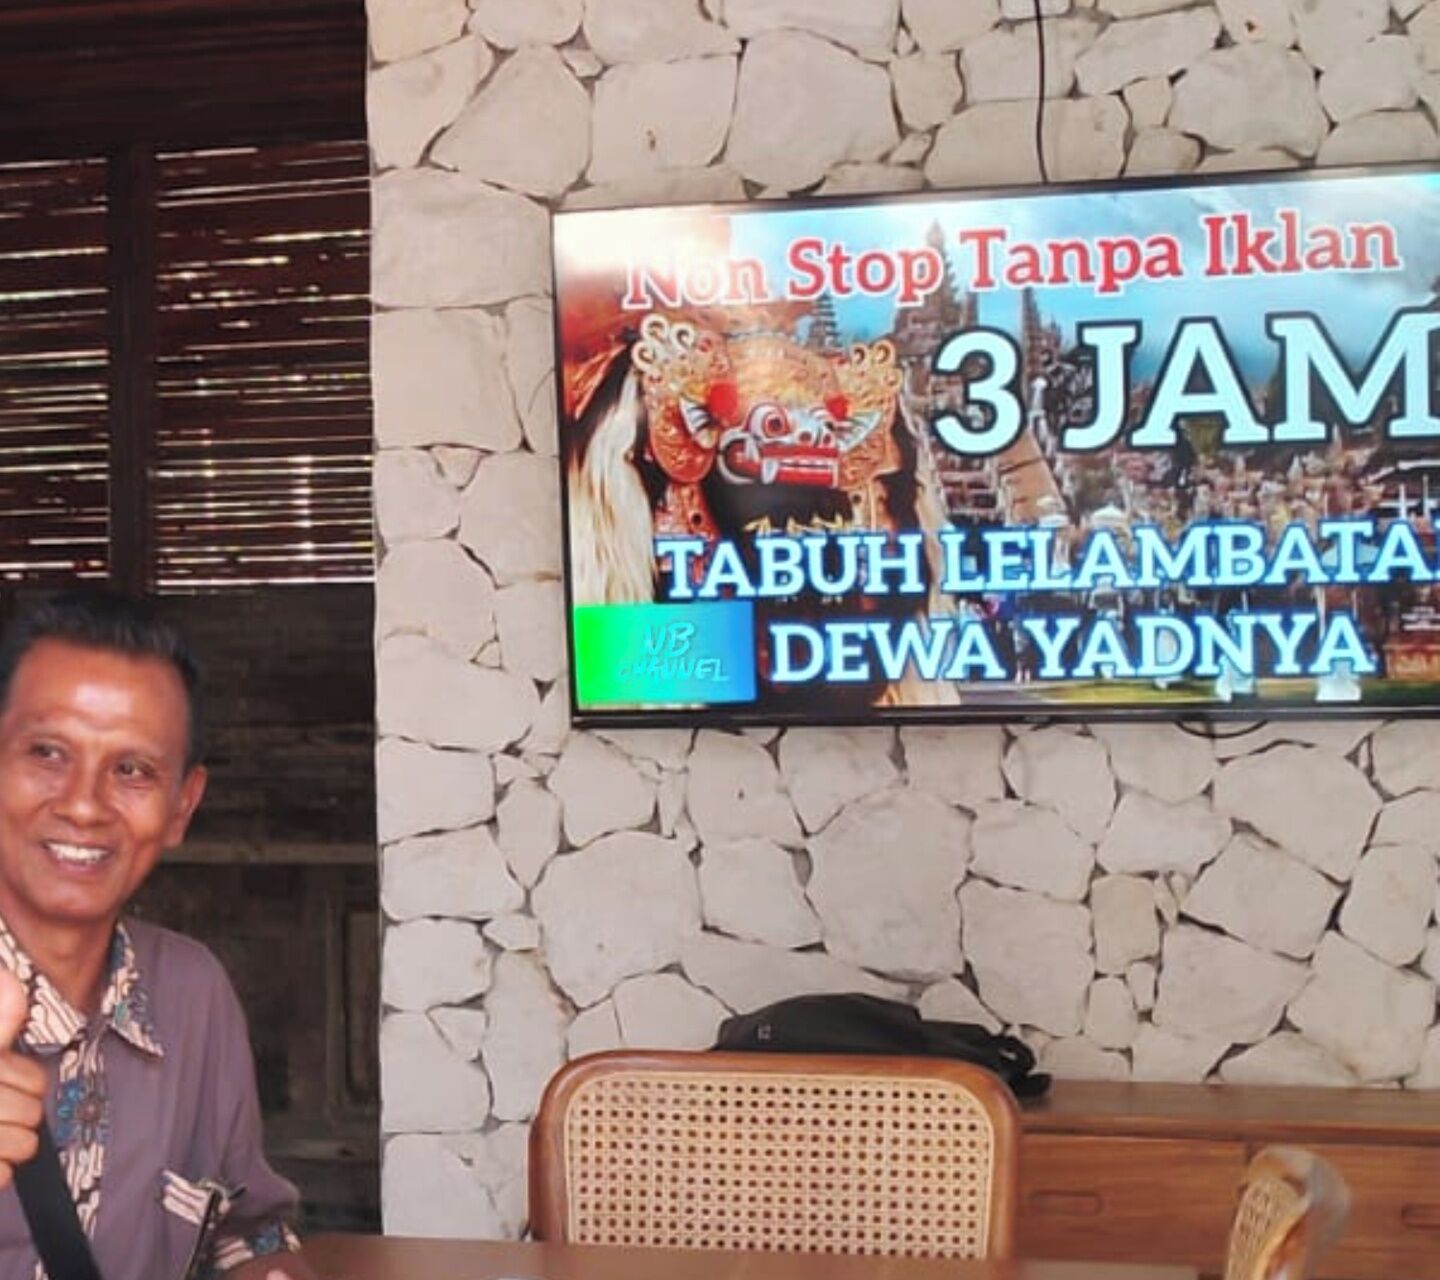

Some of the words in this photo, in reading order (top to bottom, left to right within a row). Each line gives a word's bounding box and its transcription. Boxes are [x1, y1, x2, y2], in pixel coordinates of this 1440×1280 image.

[623, 255, 770, 308] Non
[789, 238, 941, 305] Stop
[960, 229, 1182, 293] Tanpa
[1205, 212, 1398, 276] Iklan
[934, 330, 1023, 454] 3
[1063, 313, 1440, 449] JAM
[657, 532, 925, 599] TABUH
[940, 520, 1440, 592] LELAMBATA
[771, 620, 1006, 682] DEWA
[1024, 612, 1375, 678] YADNYA
